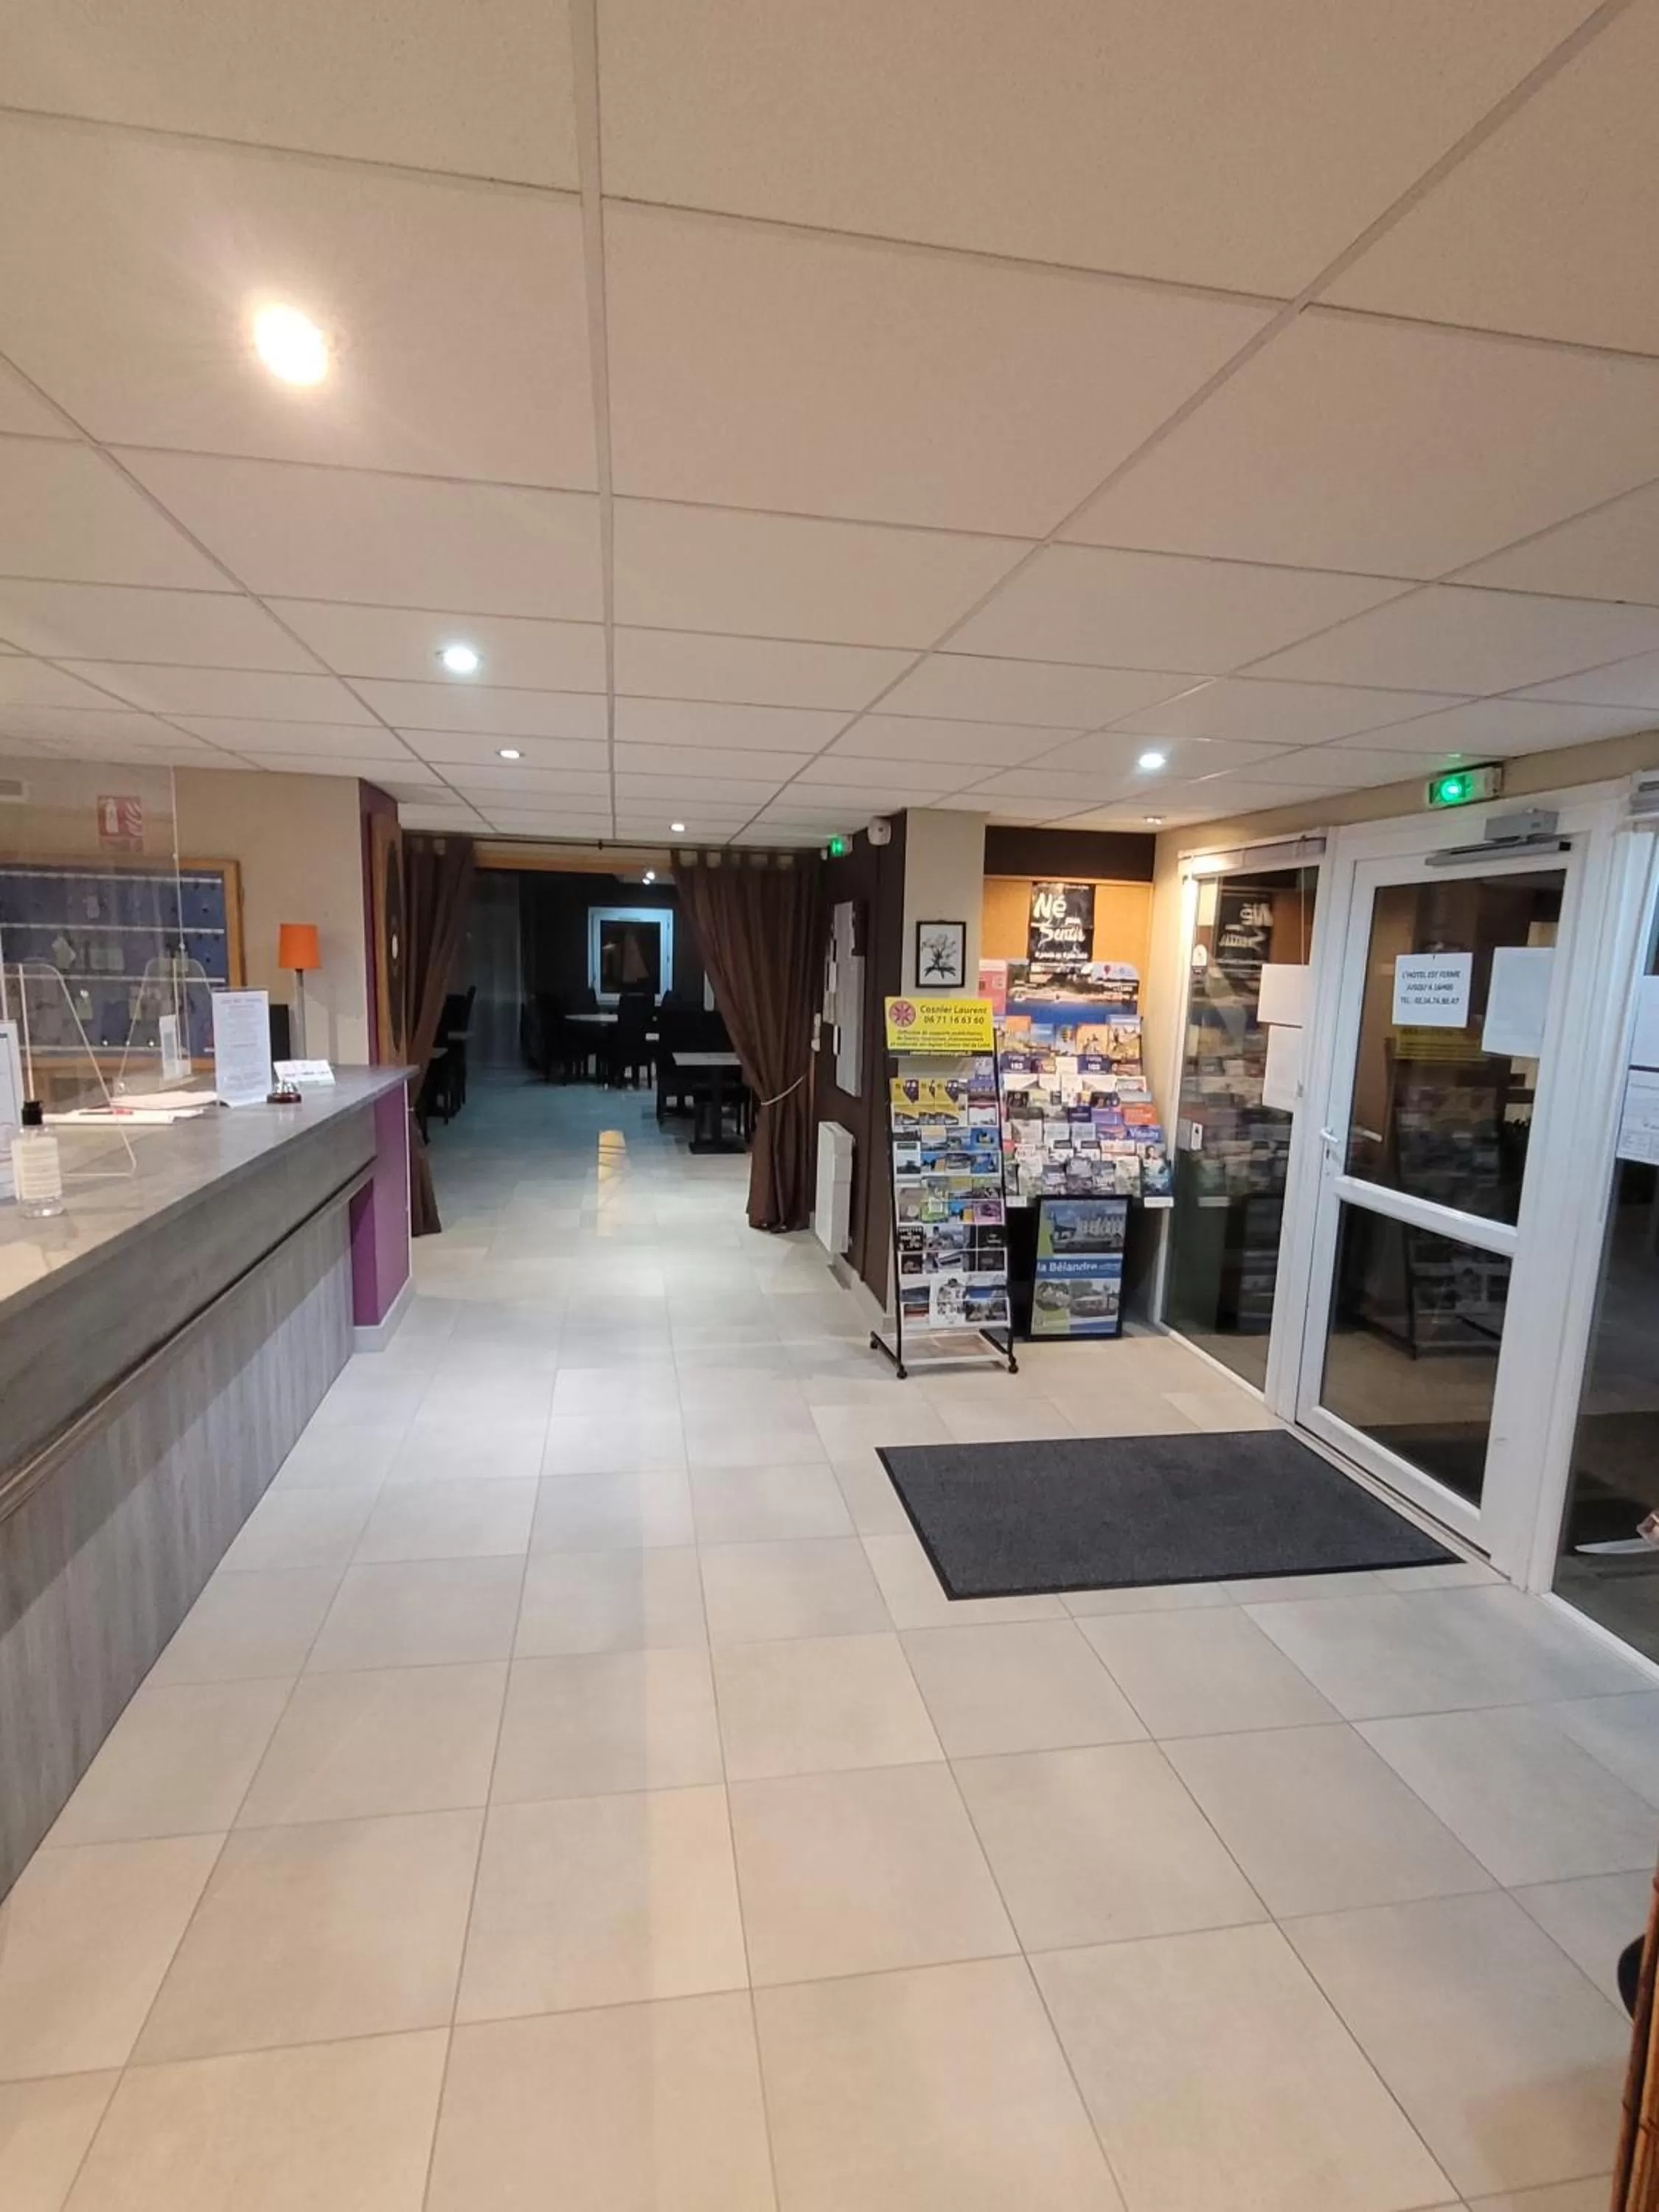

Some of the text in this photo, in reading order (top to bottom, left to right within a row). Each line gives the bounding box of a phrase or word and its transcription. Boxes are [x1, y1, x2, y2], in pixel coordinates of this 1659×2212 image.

[1033, 893, 1067, 918] Né
[920, 1005, 987, 1014] Cosnier Laurent
[936, 1016, 946, 1024] 71
[1049, 1262, 1098, 1272] Bélandre
